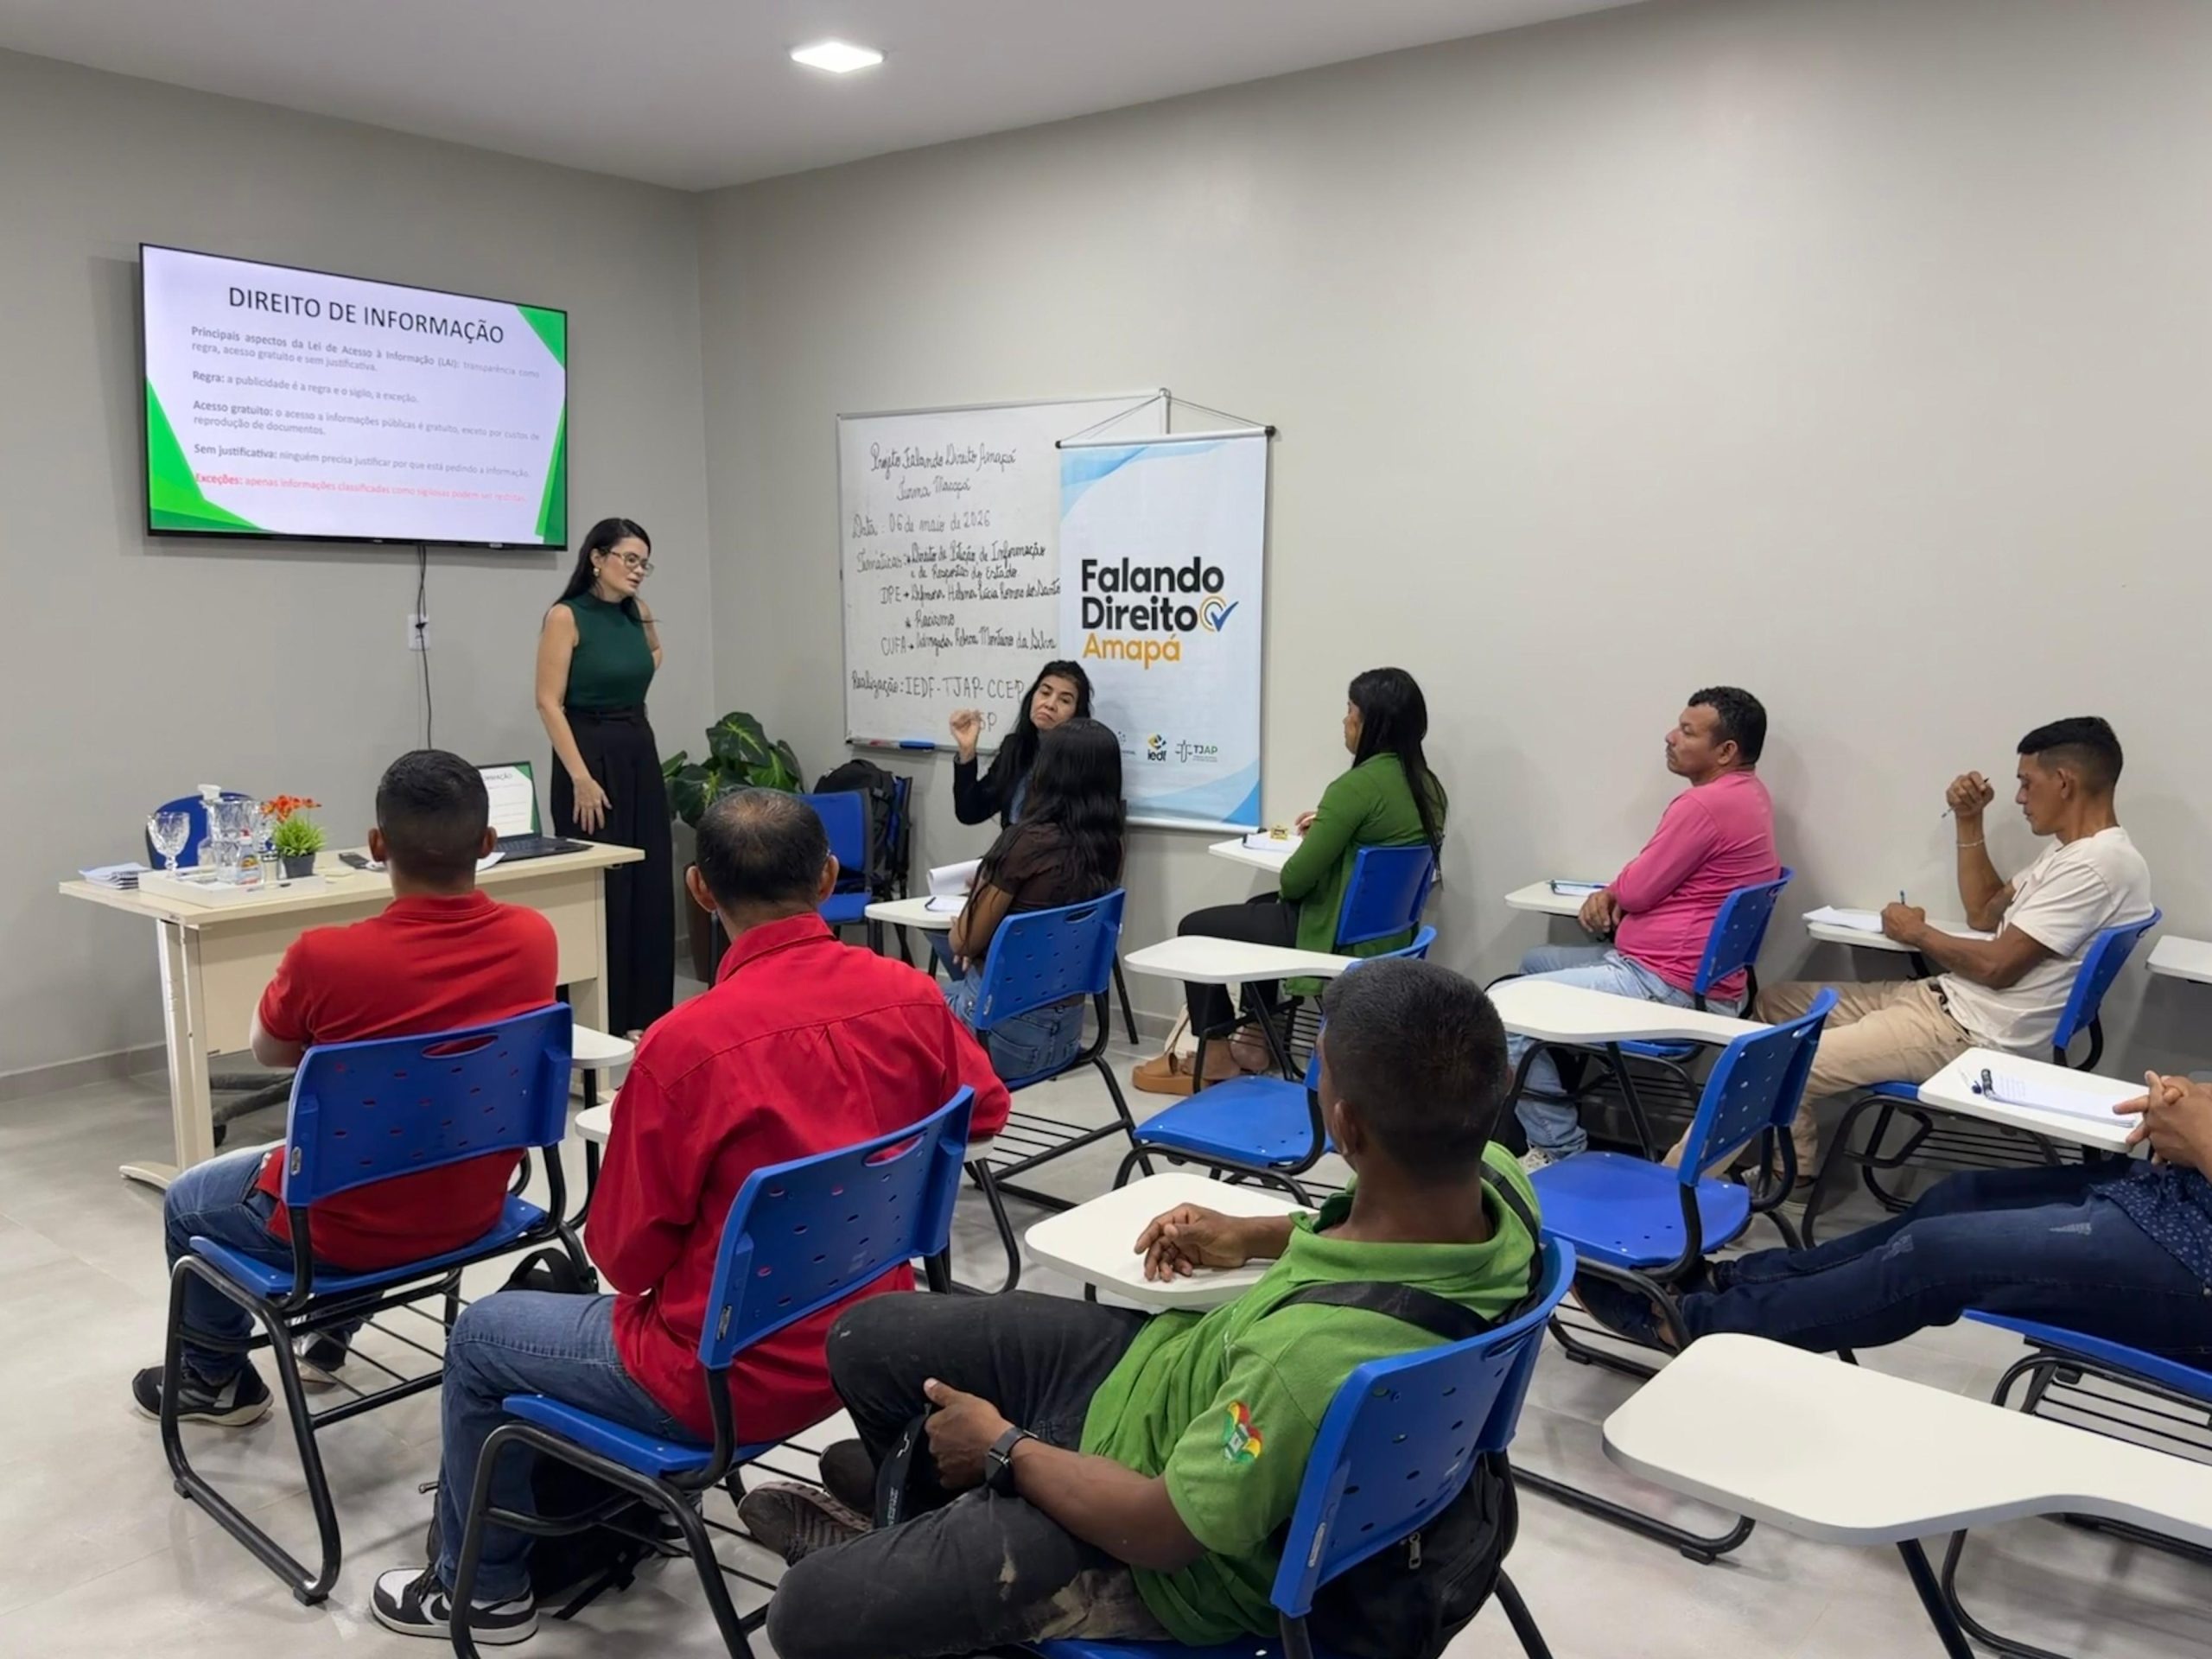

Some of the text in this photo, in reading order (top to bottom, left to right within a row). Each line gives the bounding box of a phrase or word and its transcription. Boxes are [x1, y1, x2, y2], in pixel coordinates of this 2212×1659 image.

[229, 287, 504, 344] DIREITO DE INFORMAÇÃO
[191, 326, 539, 378] Principais aspectos da Lei de Acesso à Informação (LAI): transparência como
[192, 343, 220, 355] regra,
[223, 346, 256, 357] acesso
[257, 350, 295, 362] gratuito
[305, 356, 324, 365] sem
[325, 357, 378, 372] justificativa.
[192, 371, 225, 384] Regra:
[235, 375, 289, 390] publicidade
[292, 381, 298, 391] é
[308, 385, 331, 395] regra
[349, 387, 374, 399] sigilo,
[383, 391, 419, 404] exceção.
[193, 400, 228, 412] Acesso
[231, 404, 273, 417] gratuito:
[284, 410, 315, 420] acesso
[326, 412, 379, 427] informações
[382, 419, 416, 430] públicas
[418, 421, 423, 430] é
[426, 422, 460, 435] gratuito,
[461, 427, 487, 436] exceto
[489, 429, 502, 438] por
[504, 430, 528, 440] custos
[530, 432, 540, 441] de
[194, 416, 326, 435] reprodução de documentos.
[194, 443, 216, 454] Sem
[218, 444, 277, 460] justificativa:
[279, 451, 319, 464] ninguém
[321, 454, 353, 465] precisa
[354, 454, 391, 467] justificar
[393, 460, 407, 469] por
[410, 461, 424, 472] que
[427, 461, 443, 472] está
[445, 462, 478, 474] pedindo
[486, 465, 531, 479] informação.
[871, 442, 1016, 480] Projeto Falando Direito Amapá
[196, 473, 244, 486] Exceções:
[245, 478, 277, 487] apenas
[281, 478, 335, 492] informações
[338, 480, 390, 494] classificadas
[417, 487, 451, 498] sigilosas
[452, 489, 479, 499] podem
[896, 474, 971, 501] Turma Macapá
[889, 512, 903, 533] 06
[905, 514, 914, 533] de
[919, 515, 946, 533] maio
[950, 512, 961, 531] de
[963, 510, 991, 529] 2026
[912, 542, 937, 563] Direito
[938, 545, 947, 562] de
[980, 546, 988, 563] de
[991, 540, 1046, 569] Informação
[918, 565, 928, 578] de
[986, 563, 1018, 580] Estado
[1082, 556, 1224, 594] Falando
[915, 609, 955, 628] Racismo
[1082, 595, 1198, 632] Direito
[880, 635, 906, 656] CUFA
[1016, 631, 1029, 649] da
[1082, 633, 1181, 670] Amapá
[1193, 745, 1218, 754] TJAP
